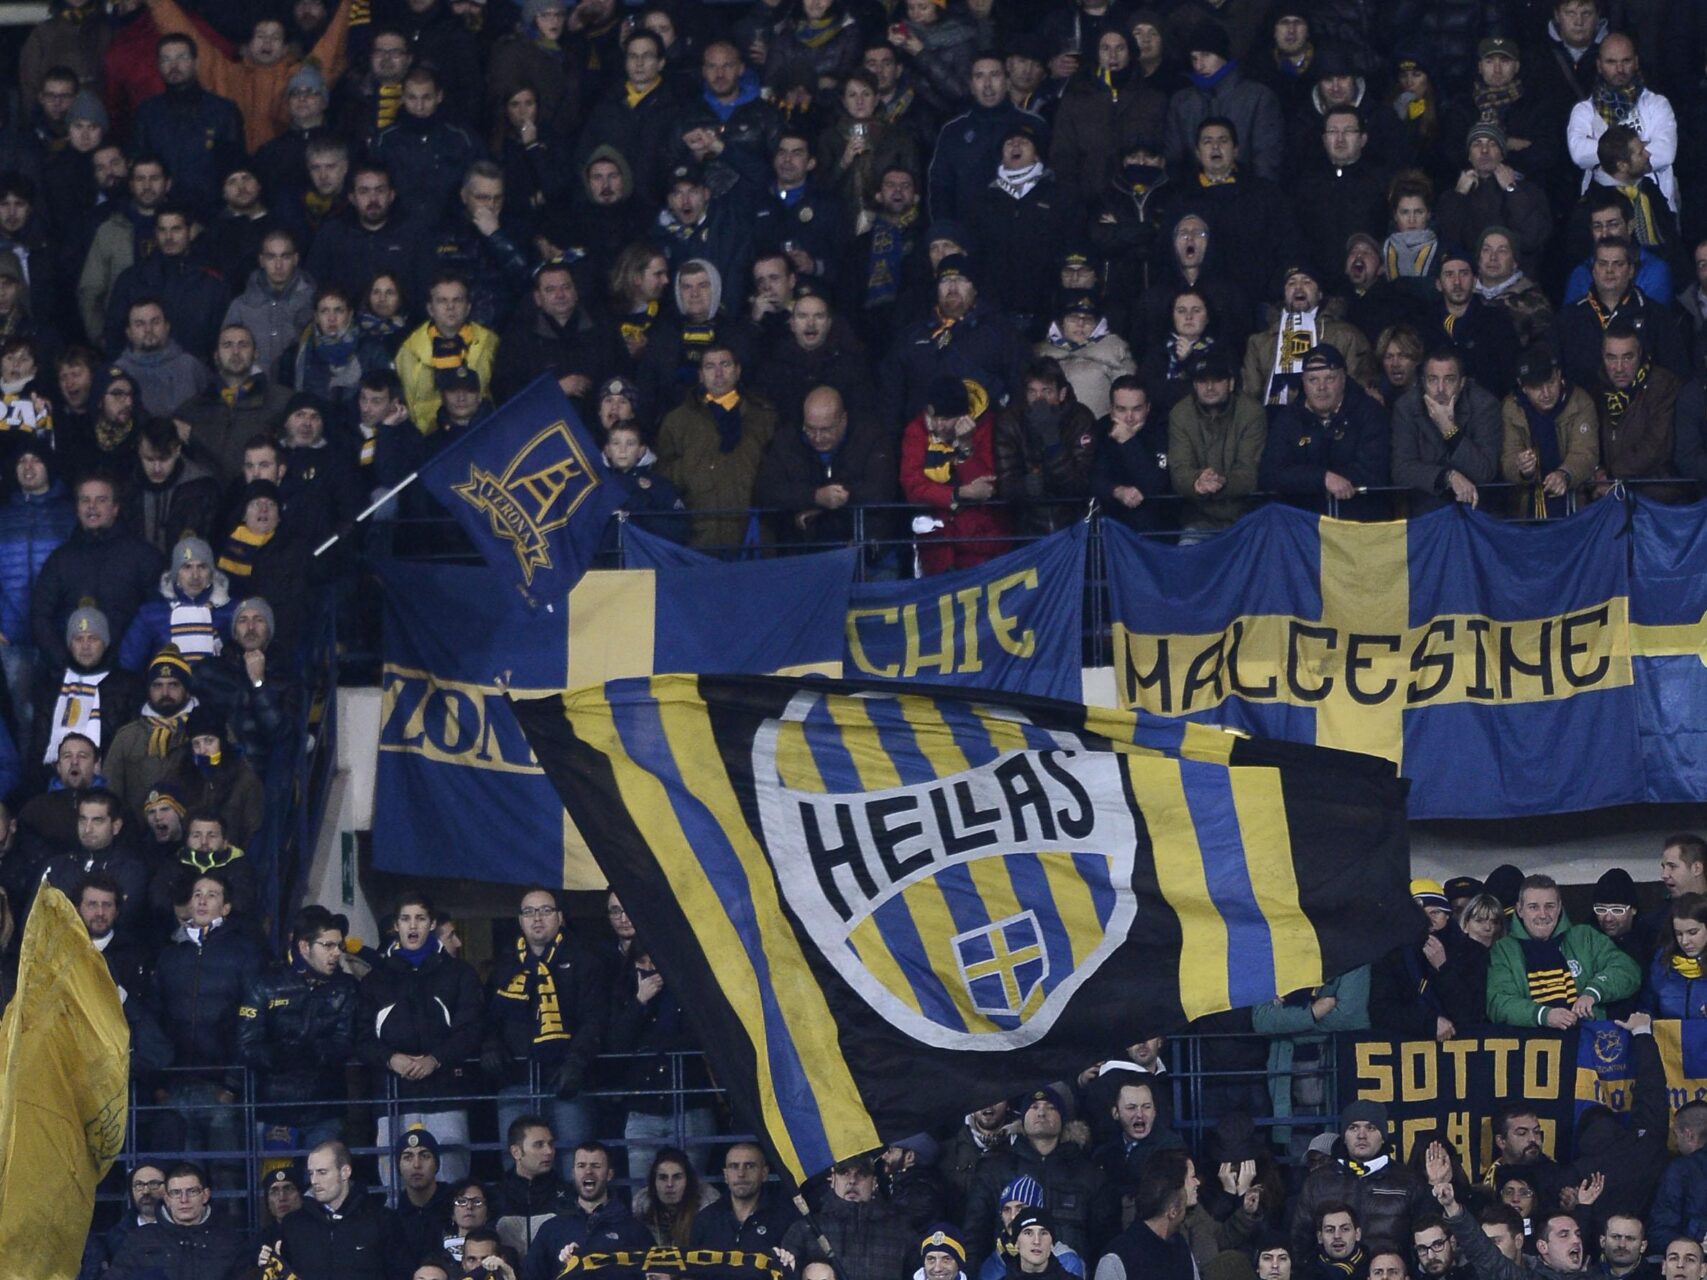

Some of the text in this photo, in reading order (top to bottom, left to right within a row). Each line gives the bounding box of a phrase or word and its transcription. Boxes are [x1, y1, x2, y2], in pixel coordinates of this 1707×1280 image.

[485, 485, 534, 544] VERONA
[847, 567, 1039, 678] CHIE
[1125, 606, 1611, 713] MALCESINE
[382, 671, 540, 767] ZON
[798, 749, 1096, 923] HELLAS
[1355, 1038, 1563, 1103] SOTTO
